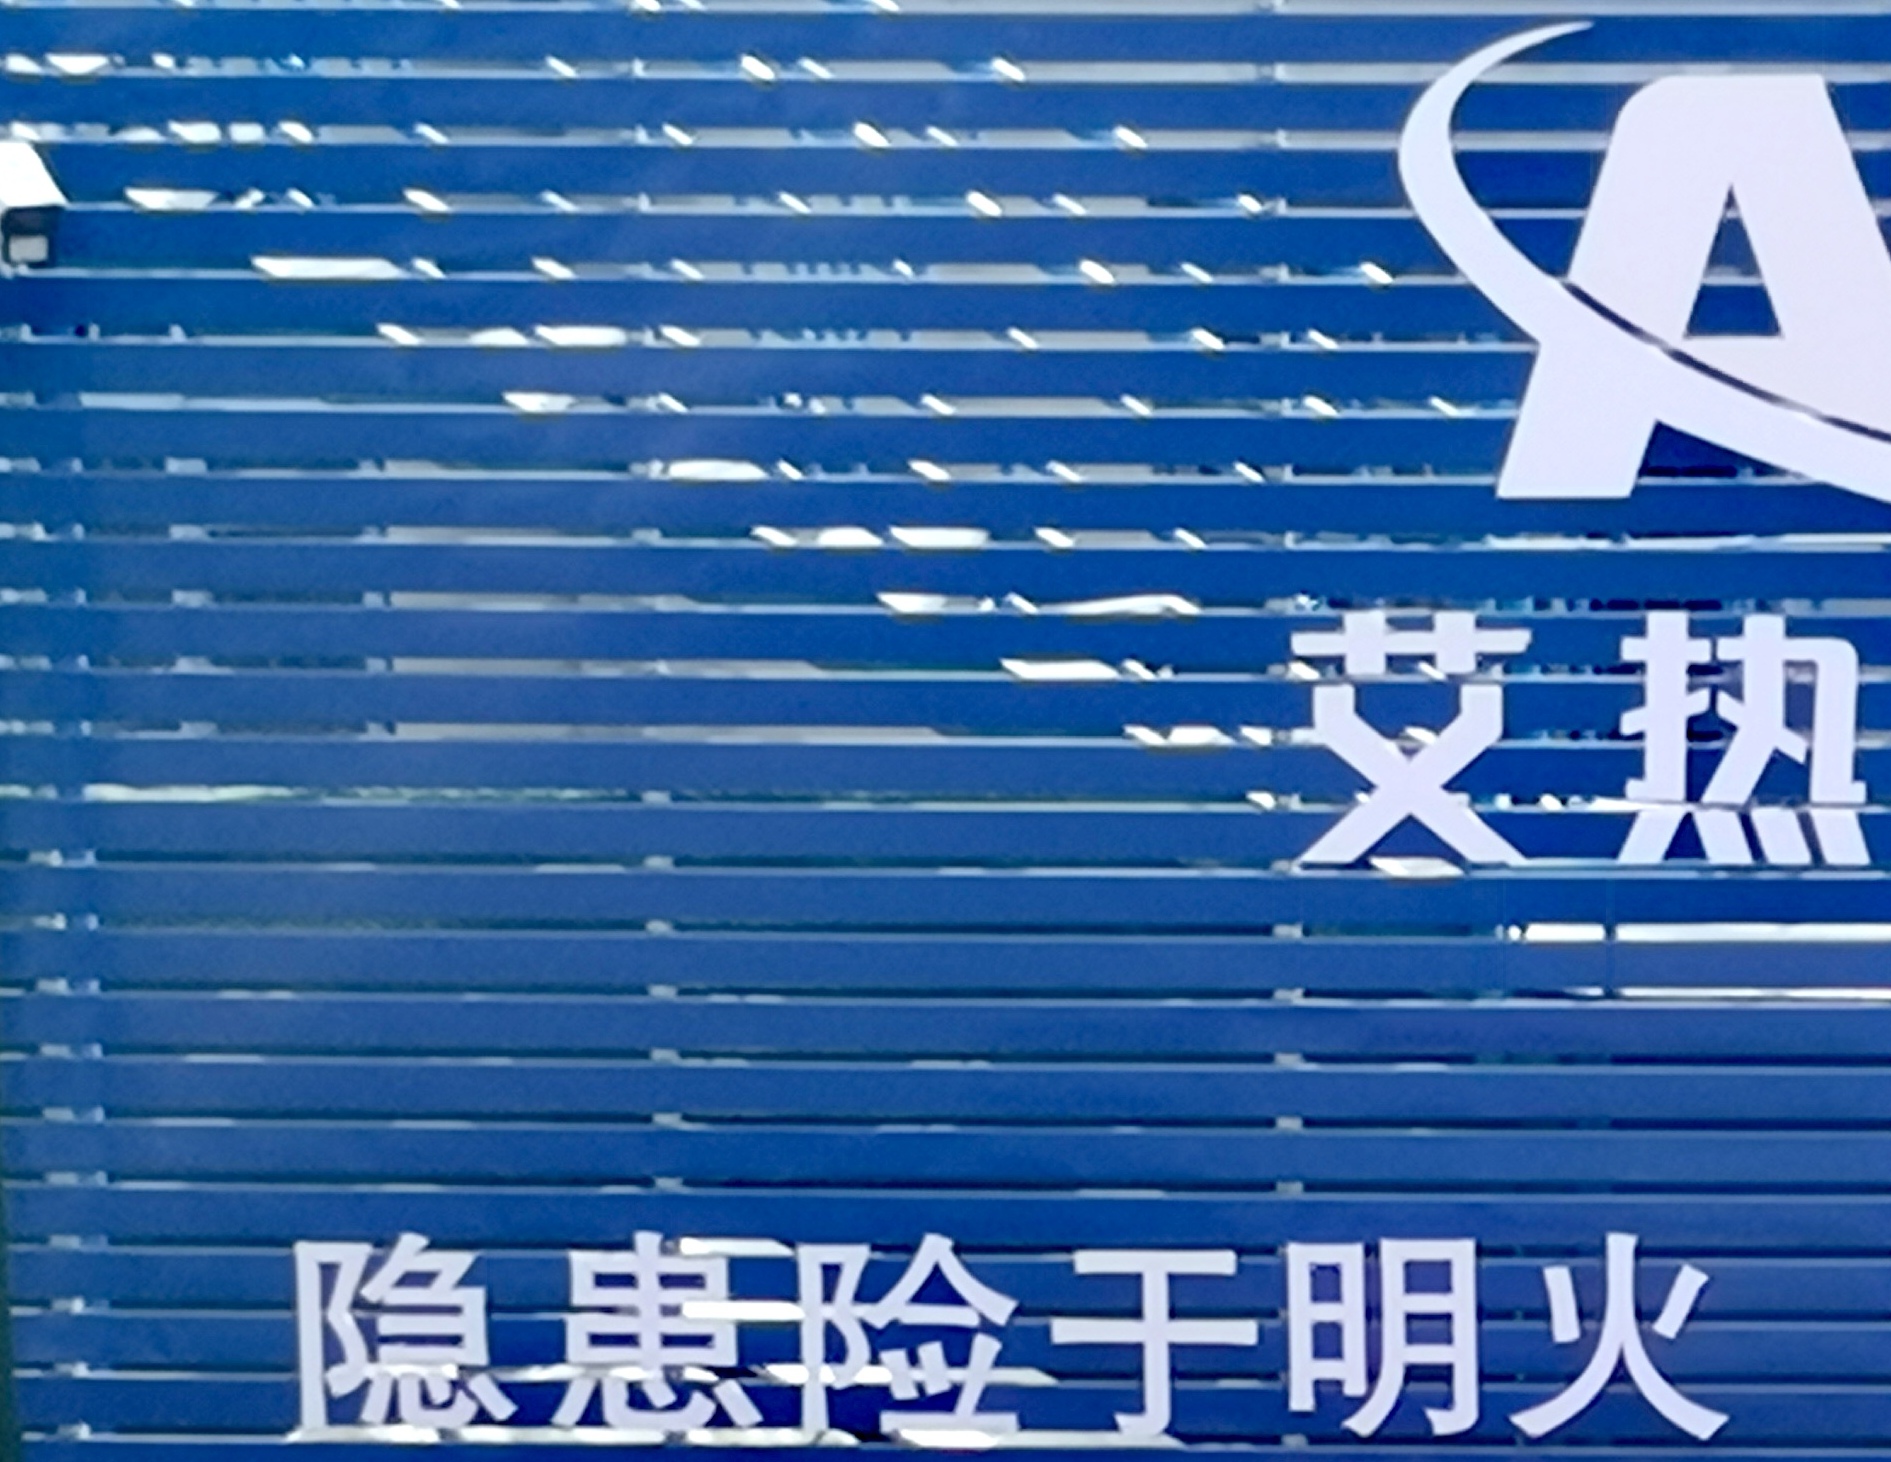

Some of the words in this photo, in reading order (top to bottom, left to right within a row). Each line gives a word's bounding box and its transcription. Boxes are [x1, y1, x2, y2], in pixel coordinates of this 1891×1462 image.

[292, 1231, 1729, 1441] 隐患险于明火
